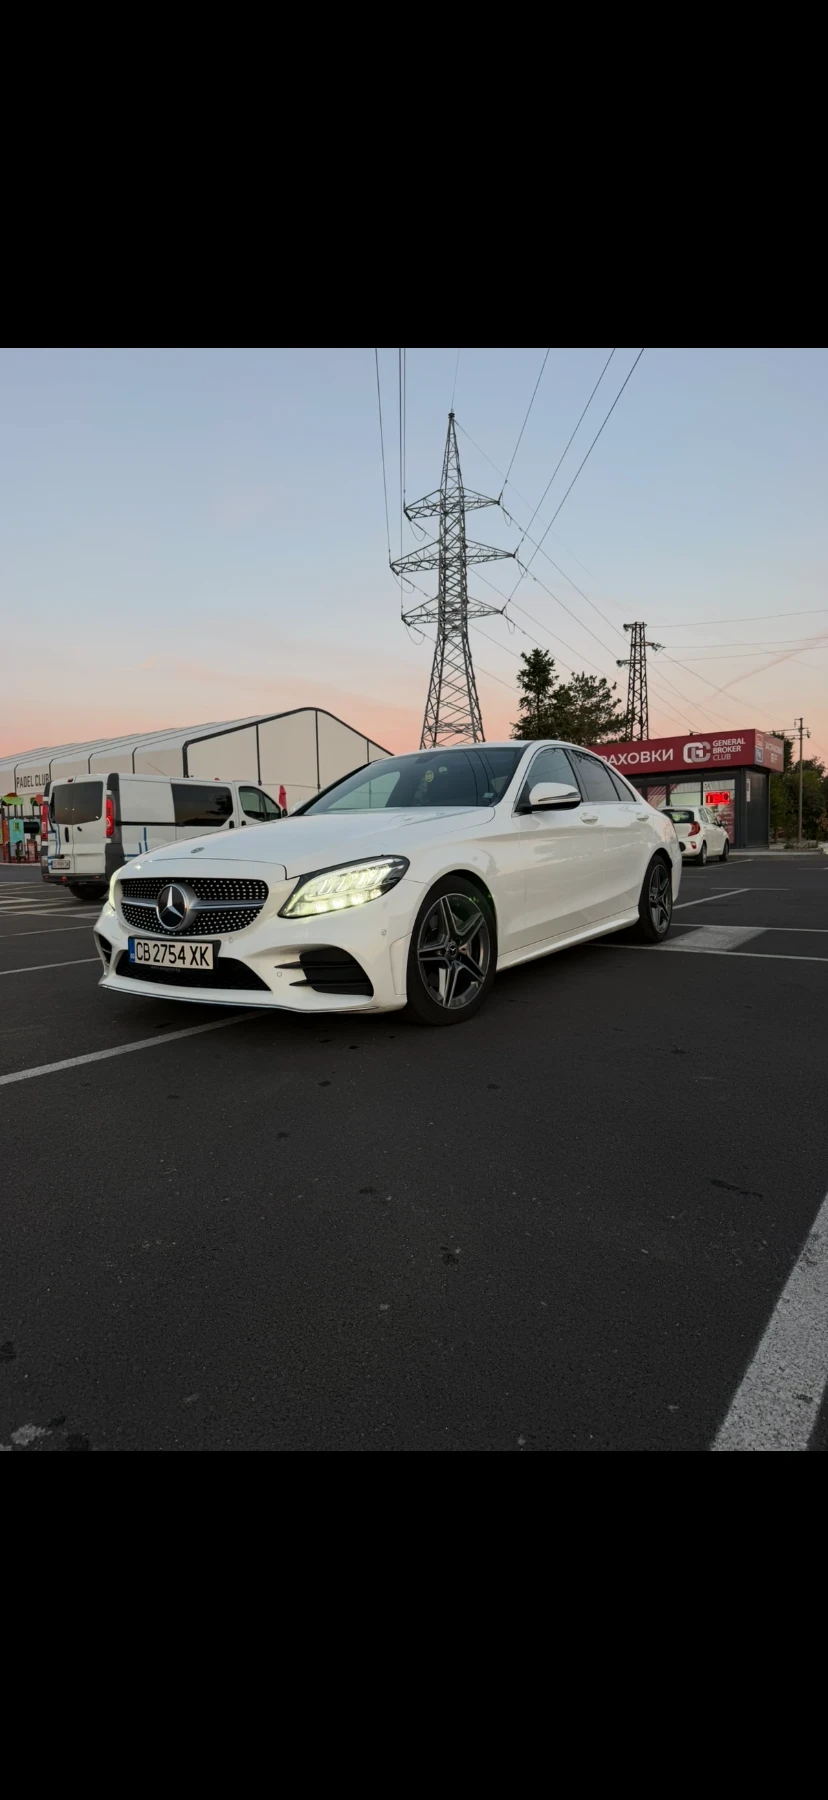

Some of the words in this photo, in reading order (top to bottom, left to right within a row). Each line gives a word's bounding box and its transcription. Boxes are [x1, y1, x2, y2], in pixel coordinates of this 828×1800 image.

[712, 738, 746, 747] GENERAL
[712, 745, 742, 754] BROKER
[712, 753, 732, 761] CLUB
[16, 775, 34, 788] PADEL
[35, 773, 50, 787] CLUB
[153, 944, 186, 965] 2754
